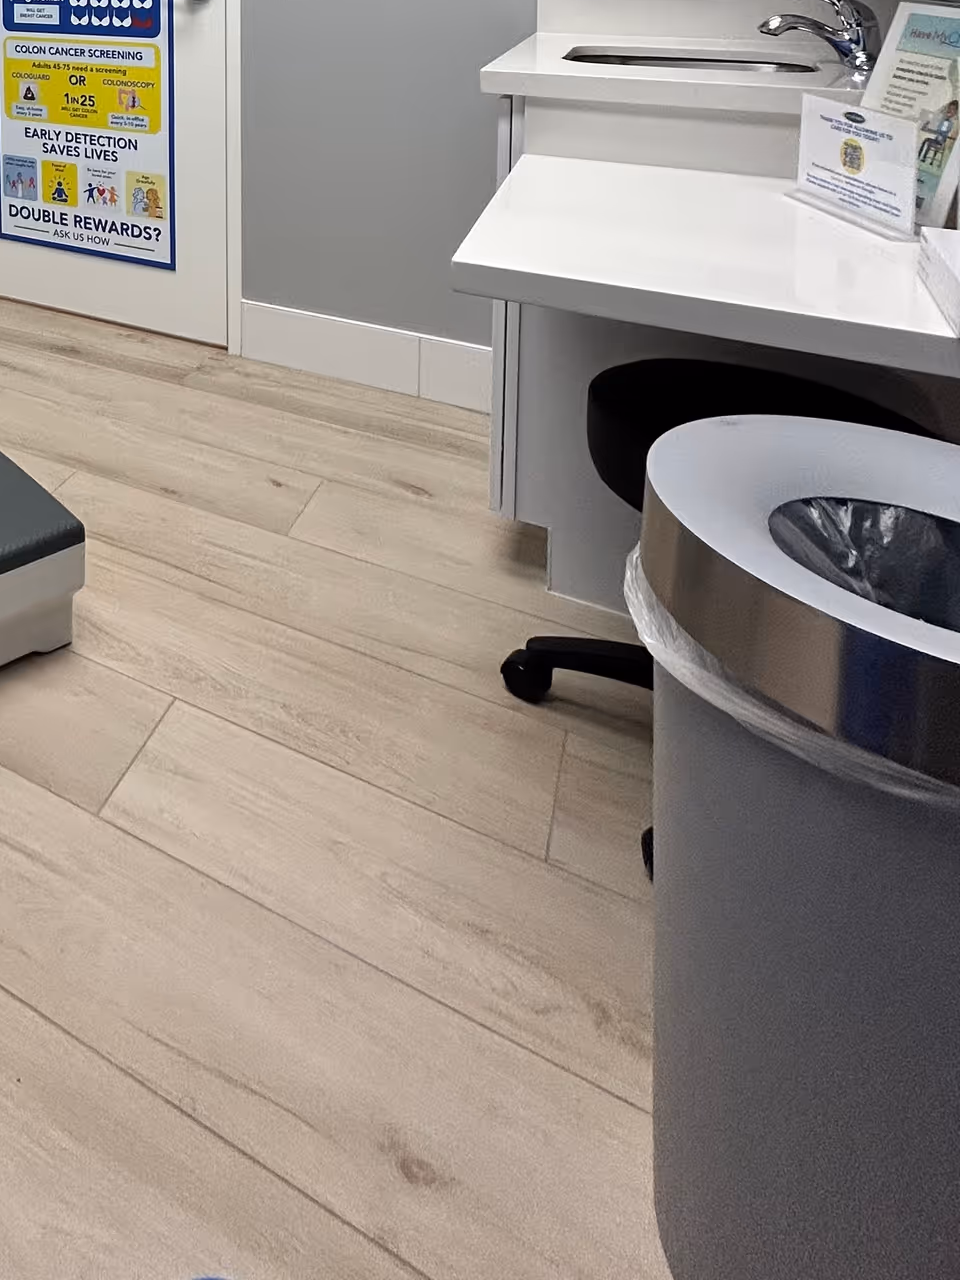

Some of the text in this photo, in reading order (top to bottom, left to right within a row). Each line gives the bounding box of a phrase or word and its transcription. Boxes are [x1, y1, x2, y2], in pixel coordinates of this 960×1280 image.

[14, 44, 143, 61] COLON CANCER SCREENING
[11, 72, 51, 81] COLOGUARD
[32, 61, 52, 70] Adults
[53, 63, 71, 71] 45-75
[95, 67, 127, 76] screening
[68, 74, 87, 87] OR
[102, 79, 156, 89] COLONOSCOPY
[64, 92, 95, 107] 1 IN 25
[24, 127, 138, 151] EARLY DETECTION
[42, 143, 119, 163] SAVES LIVES
[8, 204, 162, 242] DOUBLE REWARDS?
[53, 228, 111, 247] ASK US HOW
